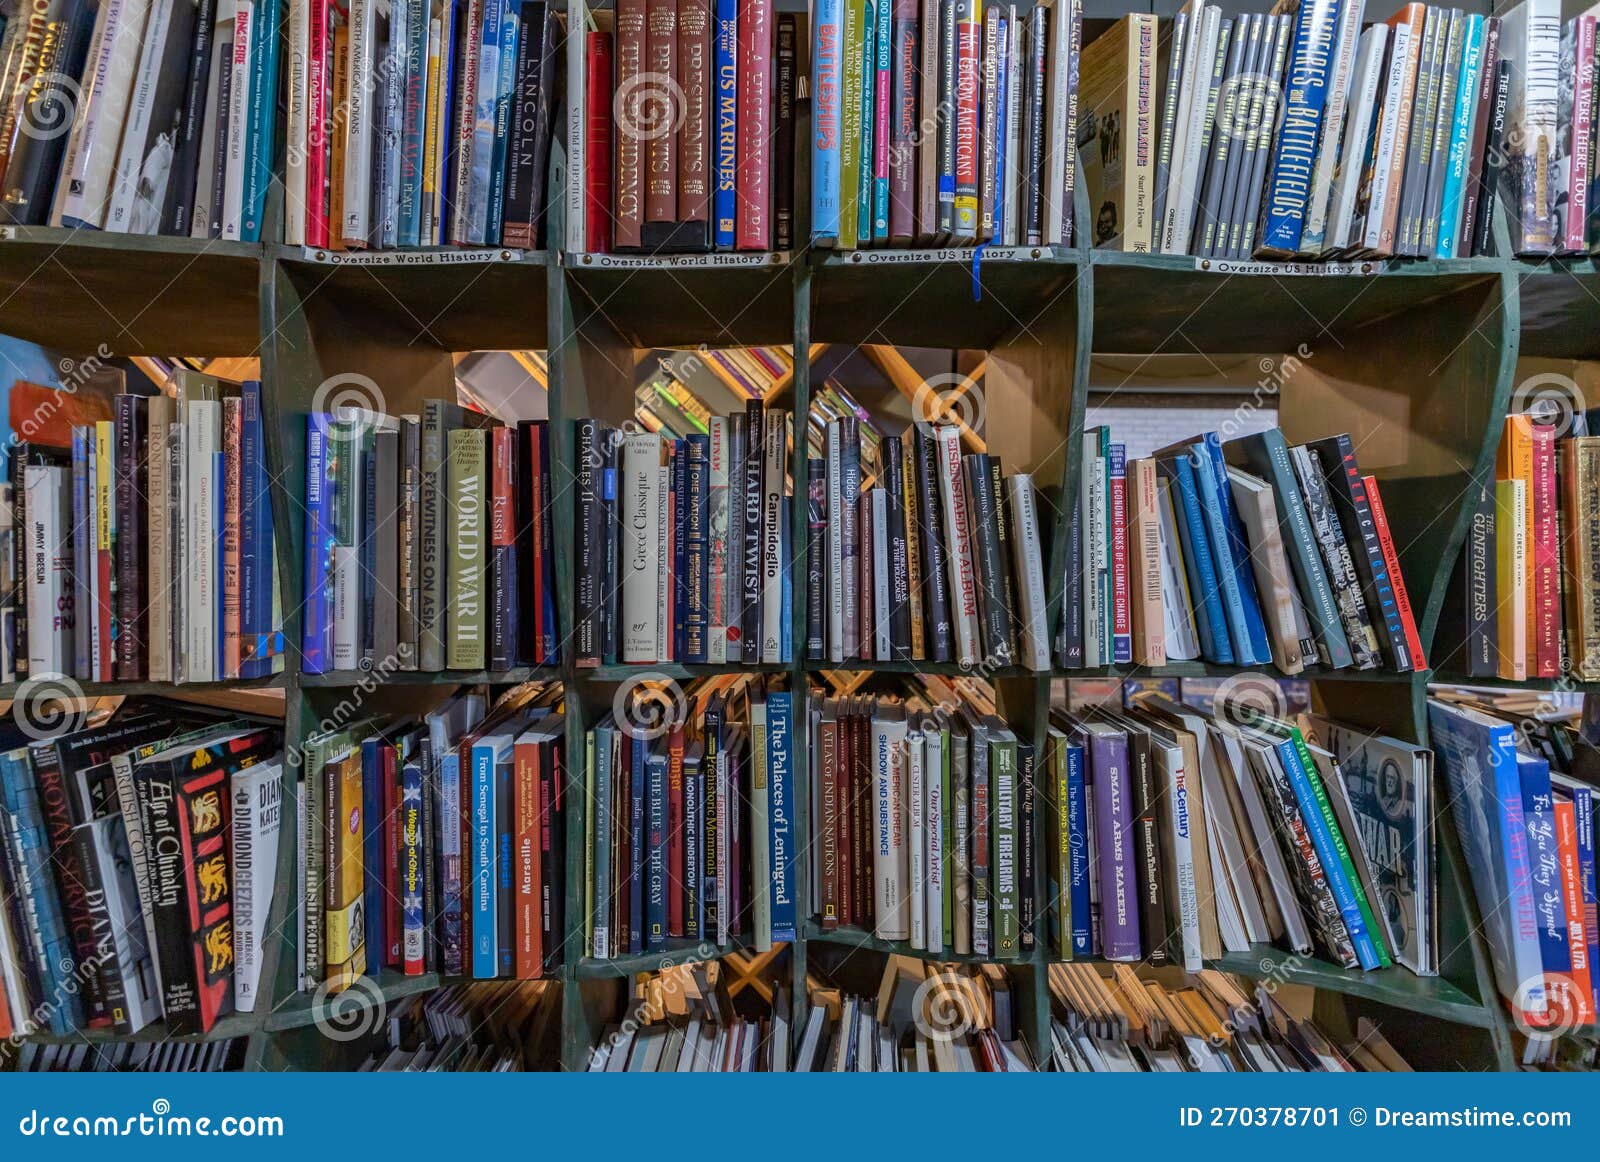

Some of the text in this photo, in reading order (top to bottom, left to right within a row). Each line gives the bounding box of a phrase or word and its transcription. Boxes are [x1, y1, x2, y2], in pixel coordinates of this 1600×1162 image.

[237, 12, 248, 35] RING
[469, 10, 479, 56] PICTORIAL
[721, 20, 728, 31] OF
[879, 17, 888, 66] Under $100
[92, 48, 110, 97] PEOPLE
[235, 45, 247, 64] FIRE
[352, 9, 362, 134] NORTH AMERICAN INDIANS
[466, 59, 476, 93] HISTORY
[957, 56, 977, 102] FELLOW
[1392, 33, 1408, 87] Las Vegas
[233, 99, 242, 114] BLAIR
[234, 70, 242, 98] LAWRENCE
[465, 95, 473, 106] OF
[520, 59, 539, 165] LINCOLN
[817, 24, 838, 151] BATTLESHIPS
[1494, 74, 1509, 132] THE LEGACY
[463, 127, 473, 140] SS
[464, 109, 472, 124] THE
[719, 65, 735, 191] US MARINES
[1454, 47, 1479, 178] The Emergence of Greece
[1575, 63, 1593, 207] WE WERE THERE, TOO!
[232, 144, 240, 159] BLAIR
[957, 107, 977, 176] AMERICANS
[1065, 95, 1078, 192] THOSE WERE THE DAYS
[1272, 89, 1319, 218] and BATTLEFIELDS
[332, 252, 493, 264] Oversize World History
[601, 256, 764, 267] Oversize World History
[869, 253, 931, 262] Oversize
[938, 252, 955, 260] US
[1219, 264, 1278, 273] Oversize
[1285, 265, 1300, 273] US
[425, 404, 437, 431] THE
[1541, 432, 1549, 452] THE
[581, 424, 594, 502] CHARLES II
[713, 423, 721, 471] VIETNAM
[151, 424, 161, 555] FRONTIER LIVING
[632, 472, 648, 529] Classique
[691, 473, 699, 530] ONE NATION
[1289, 491, 1298, 504] THE
[1541, 455, 1550, 513] PRESIDENT'S
[425, 472, 436, 562] EYEWITNESS
[493, 496, 507, 540] Russia
[745, 460, 761, 604] HARD TWIST
[767, 492, 779, 578] Campidoglio
[893, 537, 899, 545] OF
[947, 438, 975, 617] EISENSTAEDT'S ALBUM
[1025, 521, 1033, 541] PARK
[1293, 506, 1309, 542] HOLOCAUST
[1344, 454, 1400, 632] AMERICAN GREATS
[36, 521, 45, 584] JIMMY BRESLIN
[424, 567, 436, 591] ON
[456, 475, 478, 640] WORLD WAR II
[1114, 485, 1125, 629] ECONOMIC RISKS OF CLIMATE CHANGE
[1304, 544, 1320, 571] MUSEUM
[1473, 513, 1486, 621] GUNFIGHTERS
[423, 595, 435, 631] ASIA
[1316, 582, 1335, 624] WASHINGTON
[1544, 599, 1551, 610] H.
[1544, 613, 1552, 648] LANDAU
[671, 747, 683, 791] Panzer
[878, 734, 889, 856] SHADOW AND SUBSTANCE
[706, 755, 717, 875] Prehistoric Mammals
[771, 717, 789, 905] The Palaces of Leningrad
[824, 729, 835, 876] ATLAS OF INDIAN NATIONS
[1296, 740, 1347, 860] THE IRISH BRIGADE
[150, 780, 182, 906] Age of Chivalry
[477, 757, 489, 912] From Senegal to South Carolina
[687, 776, 696, 888] MONOLITHIC UNDERTOW
[930, 785, 940, 890] "Our Special Artist"
[999, 775, 1013, 892] MILITARY FIREARMS
[1110, 767, 1126, 926] SMALL ARMS MAKERS
[234, 808, 253, 926] DIAMONDGEEZERS
[522, 838, 531, 894] Marseille
[1528, 795, 1561, 941] For You They Signed
[1569, 921, 1580, 941] JULY
[1572, 952, 1585, 969] 1776
